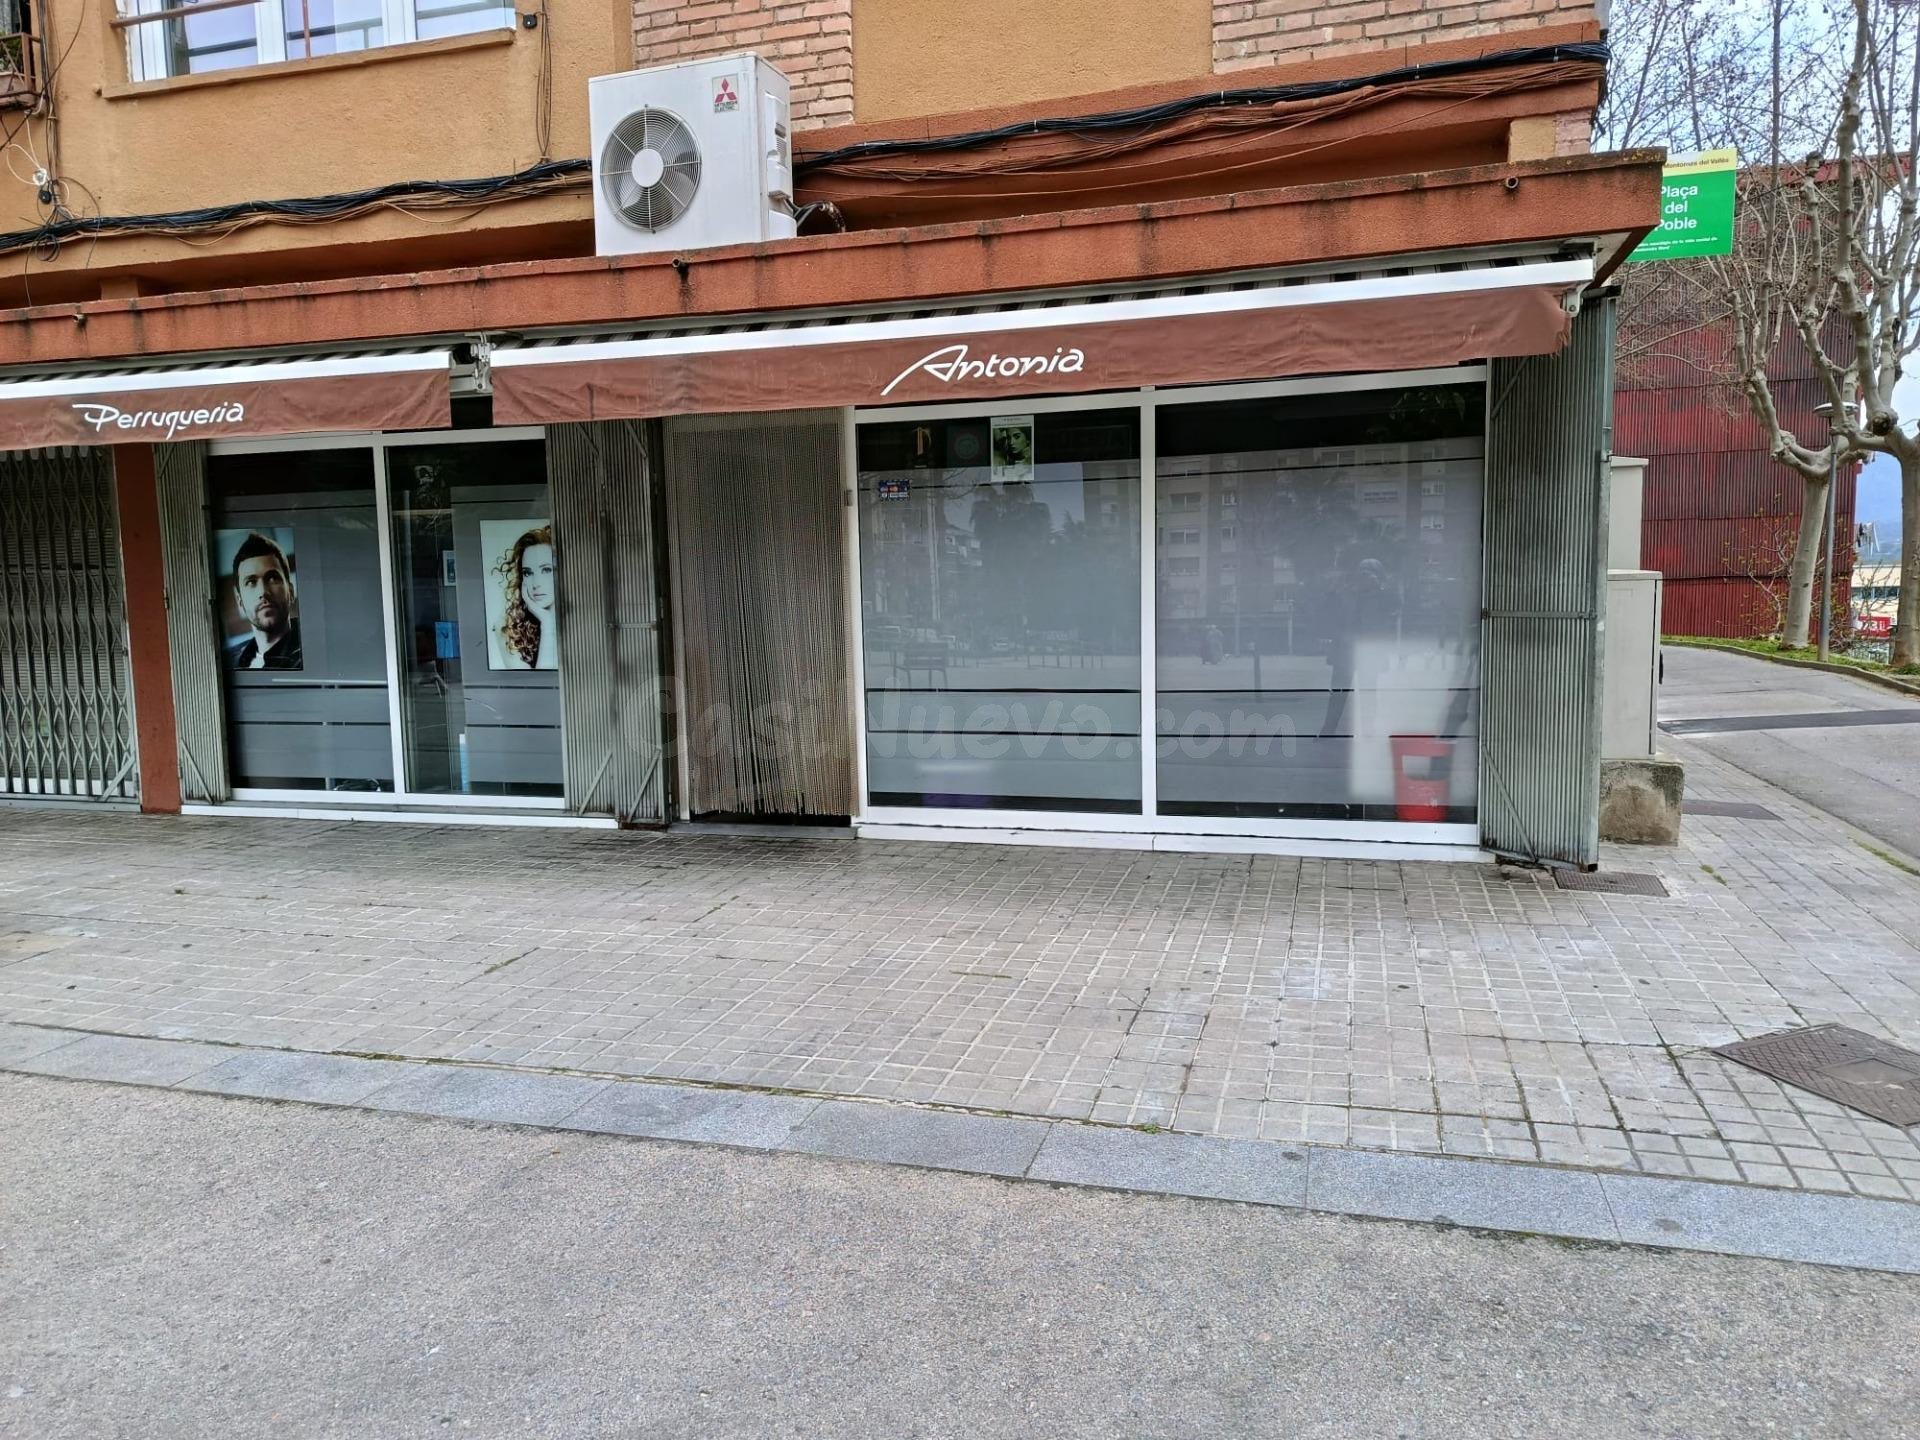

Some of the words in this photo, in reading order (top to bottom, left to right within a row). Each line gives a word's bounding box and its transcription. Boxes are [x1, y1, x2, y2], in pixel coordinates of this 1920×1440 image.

[1664, 200, 1688, 214] del
[879, 344, 1085, 397] Antonia
[71, 401, 244, 440] Perruqueria
